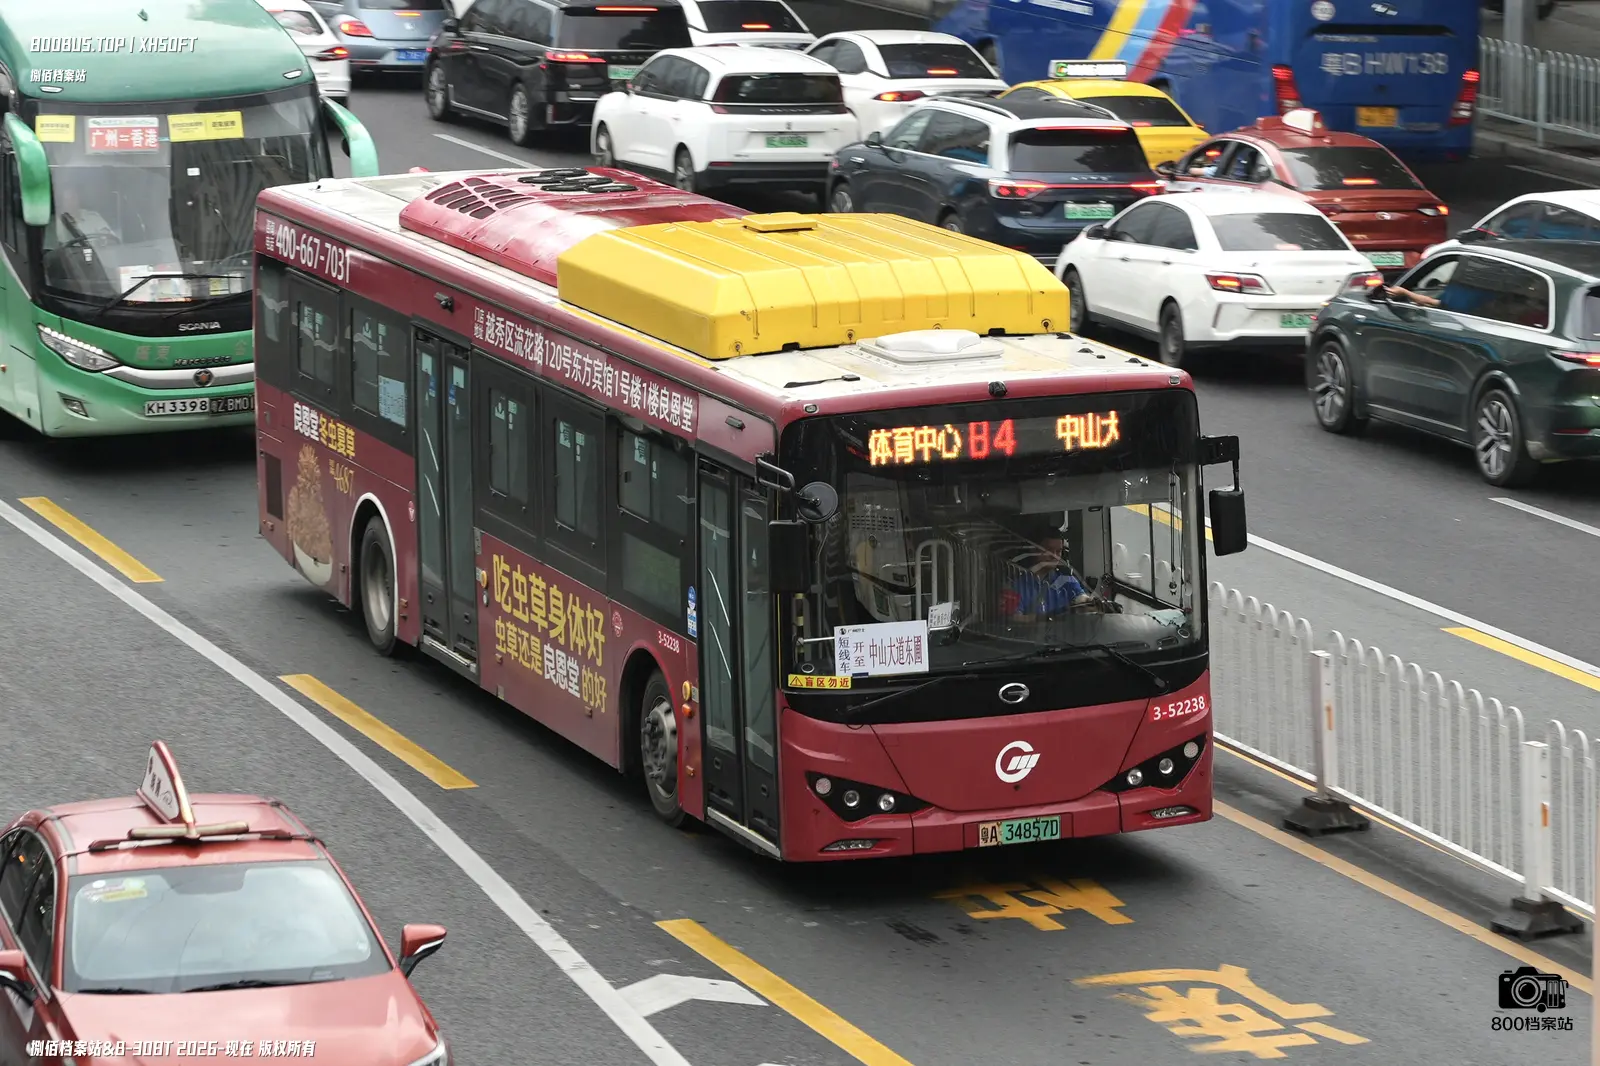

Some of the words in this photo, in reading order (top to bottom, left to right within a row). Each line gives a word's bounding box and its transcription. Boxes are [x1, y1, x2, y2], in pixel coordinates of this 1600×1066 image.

[276, 224, 350, 284] 400-667-7031
[178, 321, 221, 332] SCANIA
[147, 402, 165, 414] KH
[168, 400, 208, 413] 3398
[868, 423, 963, 466] 体育中心
[1056, 410, 1120, 451] 中山大
[492, 554, 606, 667] 吃虫草身体好
[658, 630, 680, 654] 3-52238
[805, 676, 850, 689] 盲区勿近
[1153, 696, 1206, 721] 3-52238
